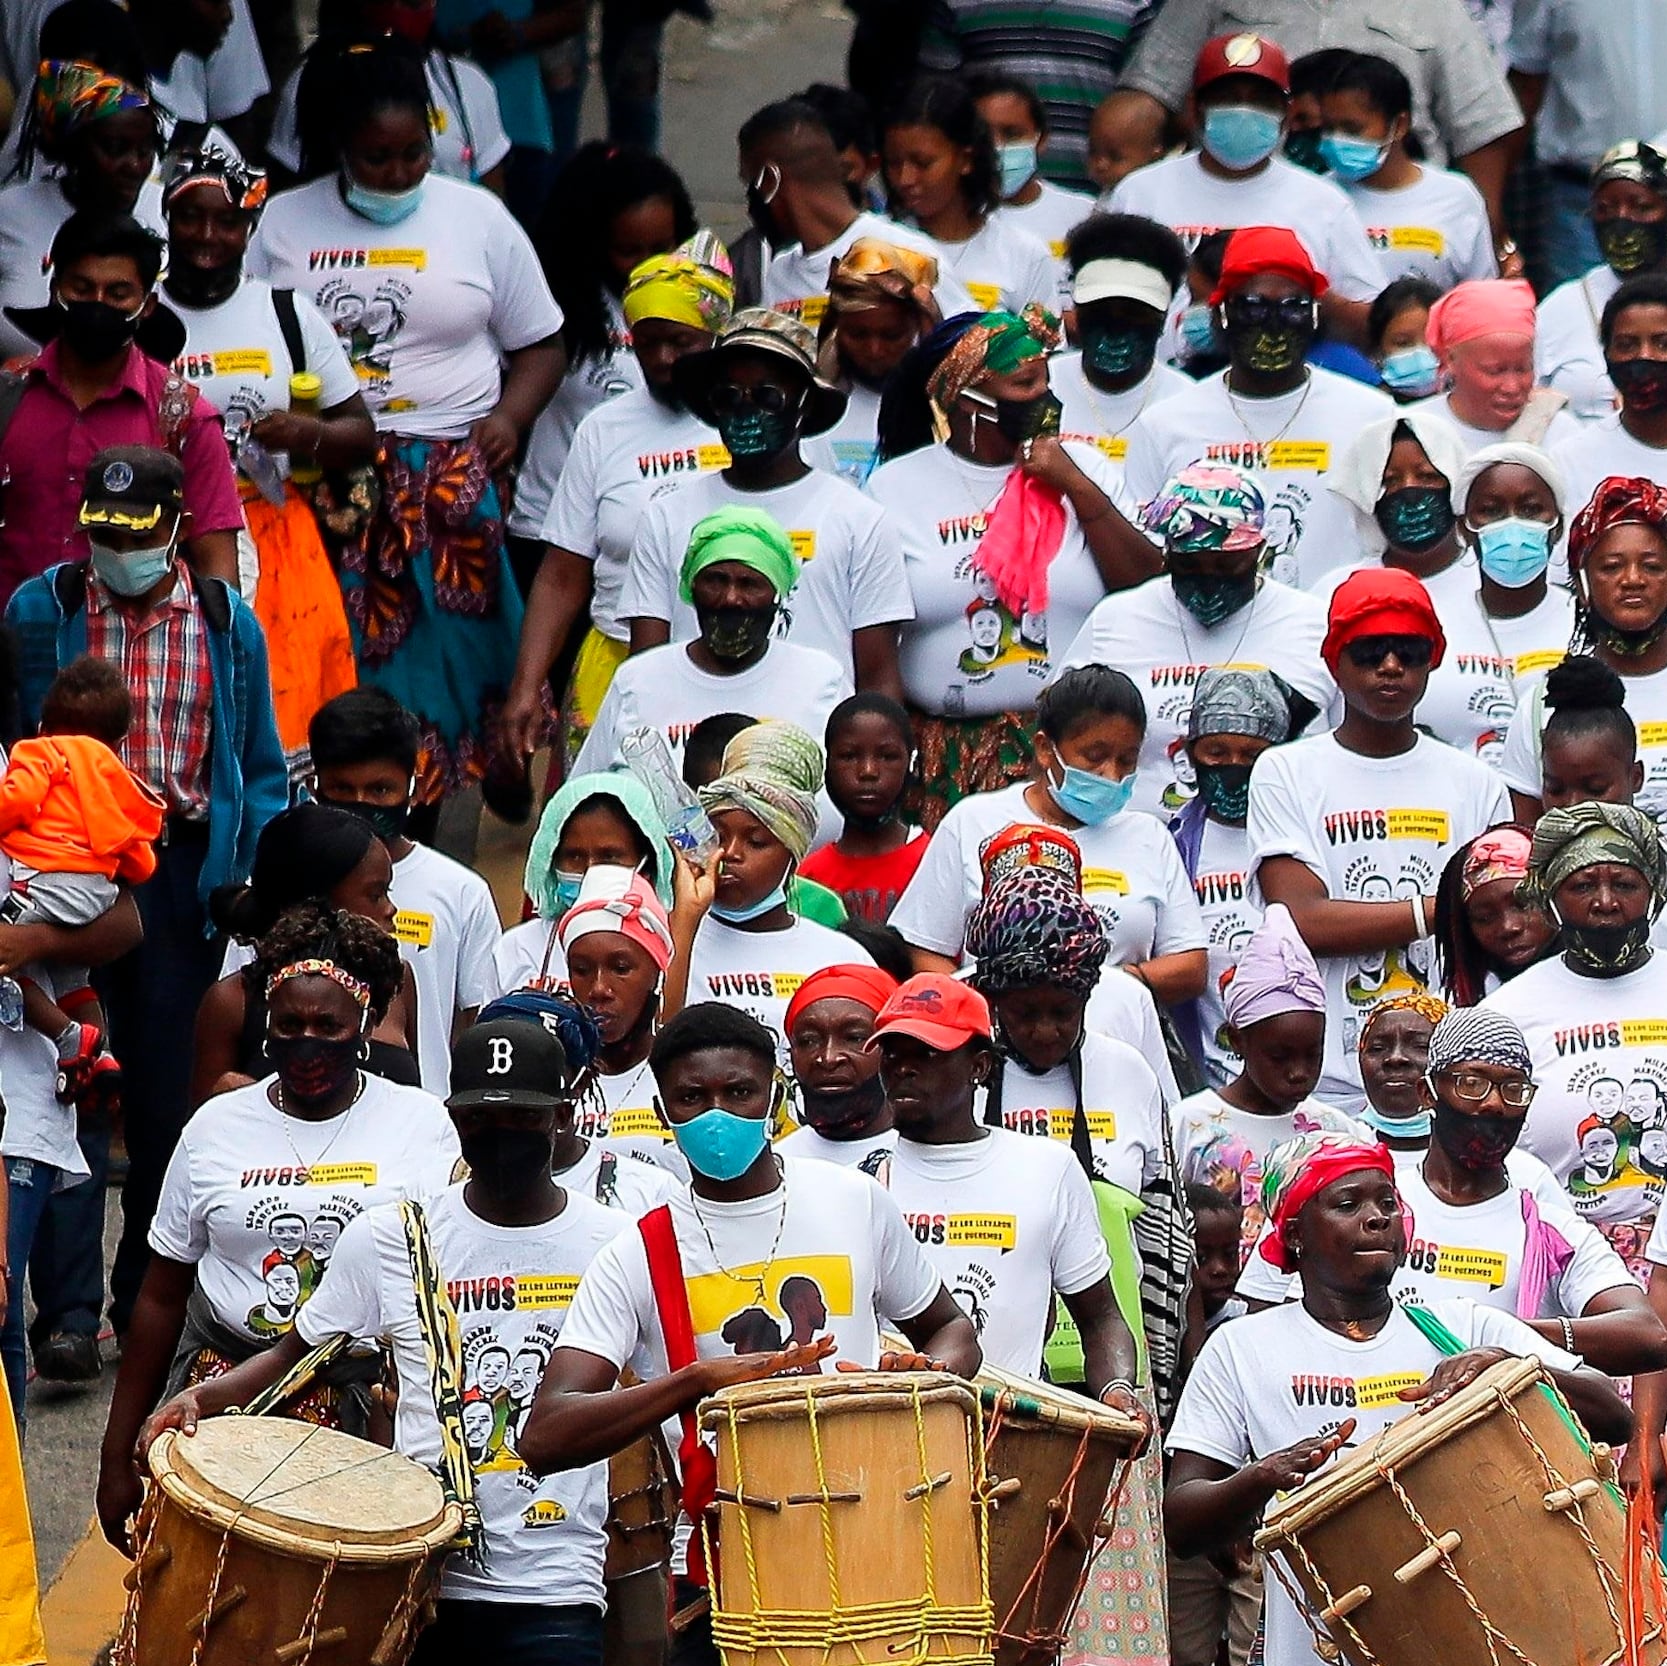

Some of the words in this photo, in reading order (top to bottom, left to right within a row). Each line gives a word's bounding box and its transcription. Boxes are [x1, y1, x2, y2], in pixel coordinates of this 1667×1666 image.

[639, 449, 697, 478] VIVOS
[1325, 810, 1387, 847] VIVOS
[1195, 872, 1248, 907] VIVO
[707, 972, 774, 997] VIVOS
[1554, 1022, 1620, 1057] VIVOS
[487, 1038, 513, 1074] B
[240, 1166, 307, 1188] VIVOS
[964, 1232, 1003, 1240] QUEREMOS
[975, 1221, 1012, 1229] LLEVARON
[1454, 1267, 1492, 1277] QUEREMOS
[1466, 1256, 1503, 1265] LLEVARON
[956, 1275, 991, 1300] MARTINEZ
[967, 1263, 997, 1288] MILTON
[447, 1277, 516, 1314] VIVOS
[1291, 1375, 1357, 1408] VIVOS
